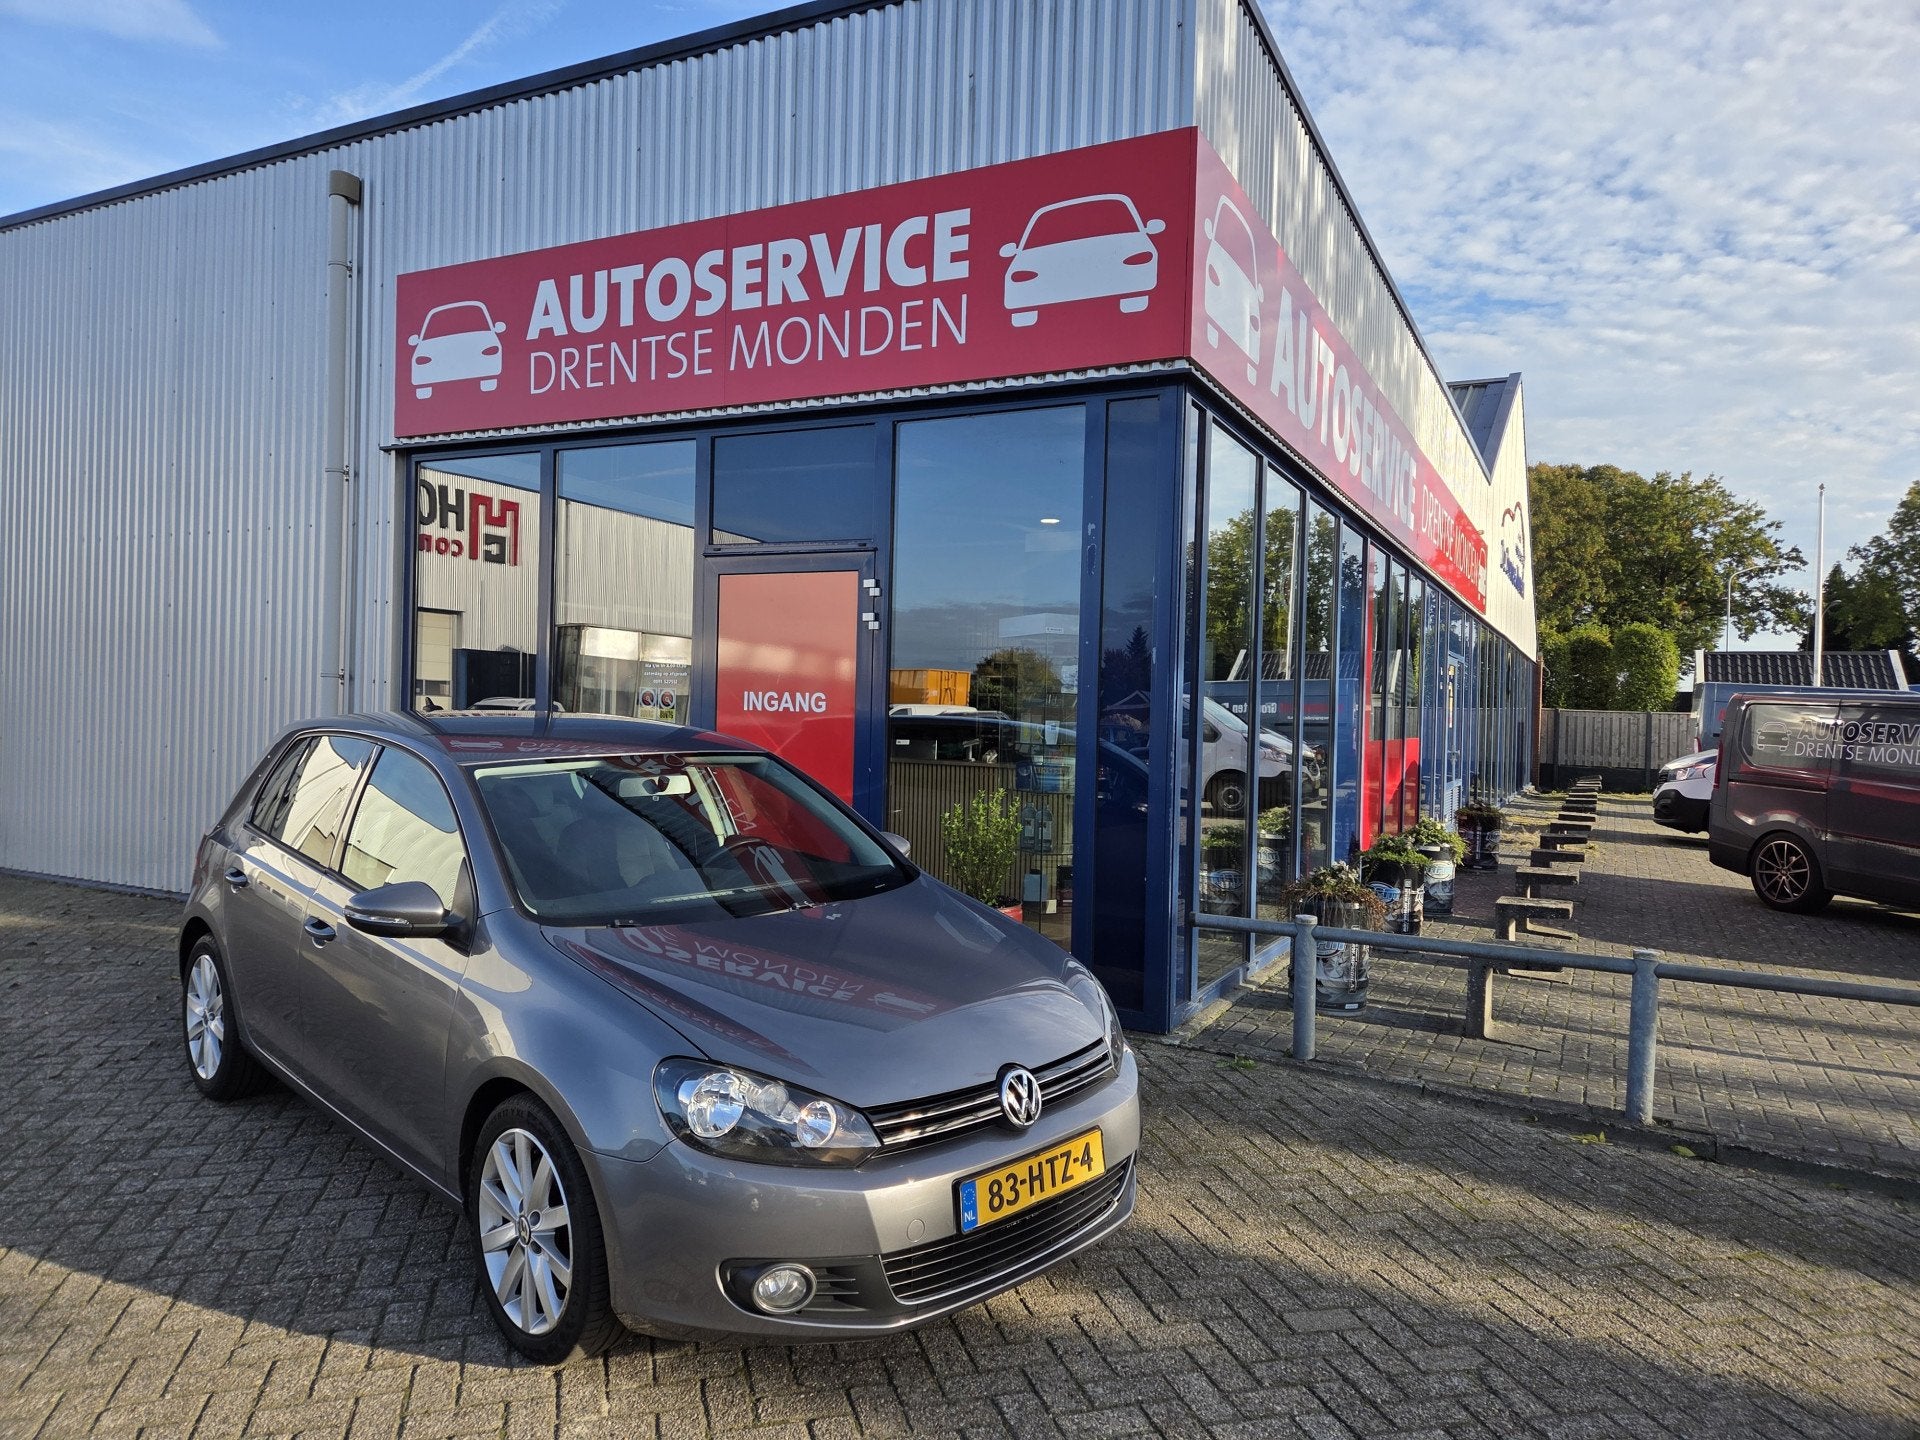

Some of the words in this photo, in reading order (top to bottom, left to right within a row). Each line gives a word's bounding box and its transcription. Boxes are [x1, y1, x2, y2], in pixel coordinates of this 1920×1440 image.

[526, 208, 971, 341] AUTOSERVICE
[530, 328, 713, 395] DRENTSE
[730, 294, 967, 371] MONDEN
[1270, 286, 1417, 531] AUTOSERVICE
[1421, 484, 1454, 561] DRENTSE
[1454, 525, 1479, 586] MONDEN
[743, 691, 826, 713] INGANG
[1797, 719, 1920, 747] AUTOSERV
[1795, 741, 1863, 761] DRENTSE
[988, 1141, 1094, 1214] 83-HTZ-4
[964, 1210, 976, 1222] NL
